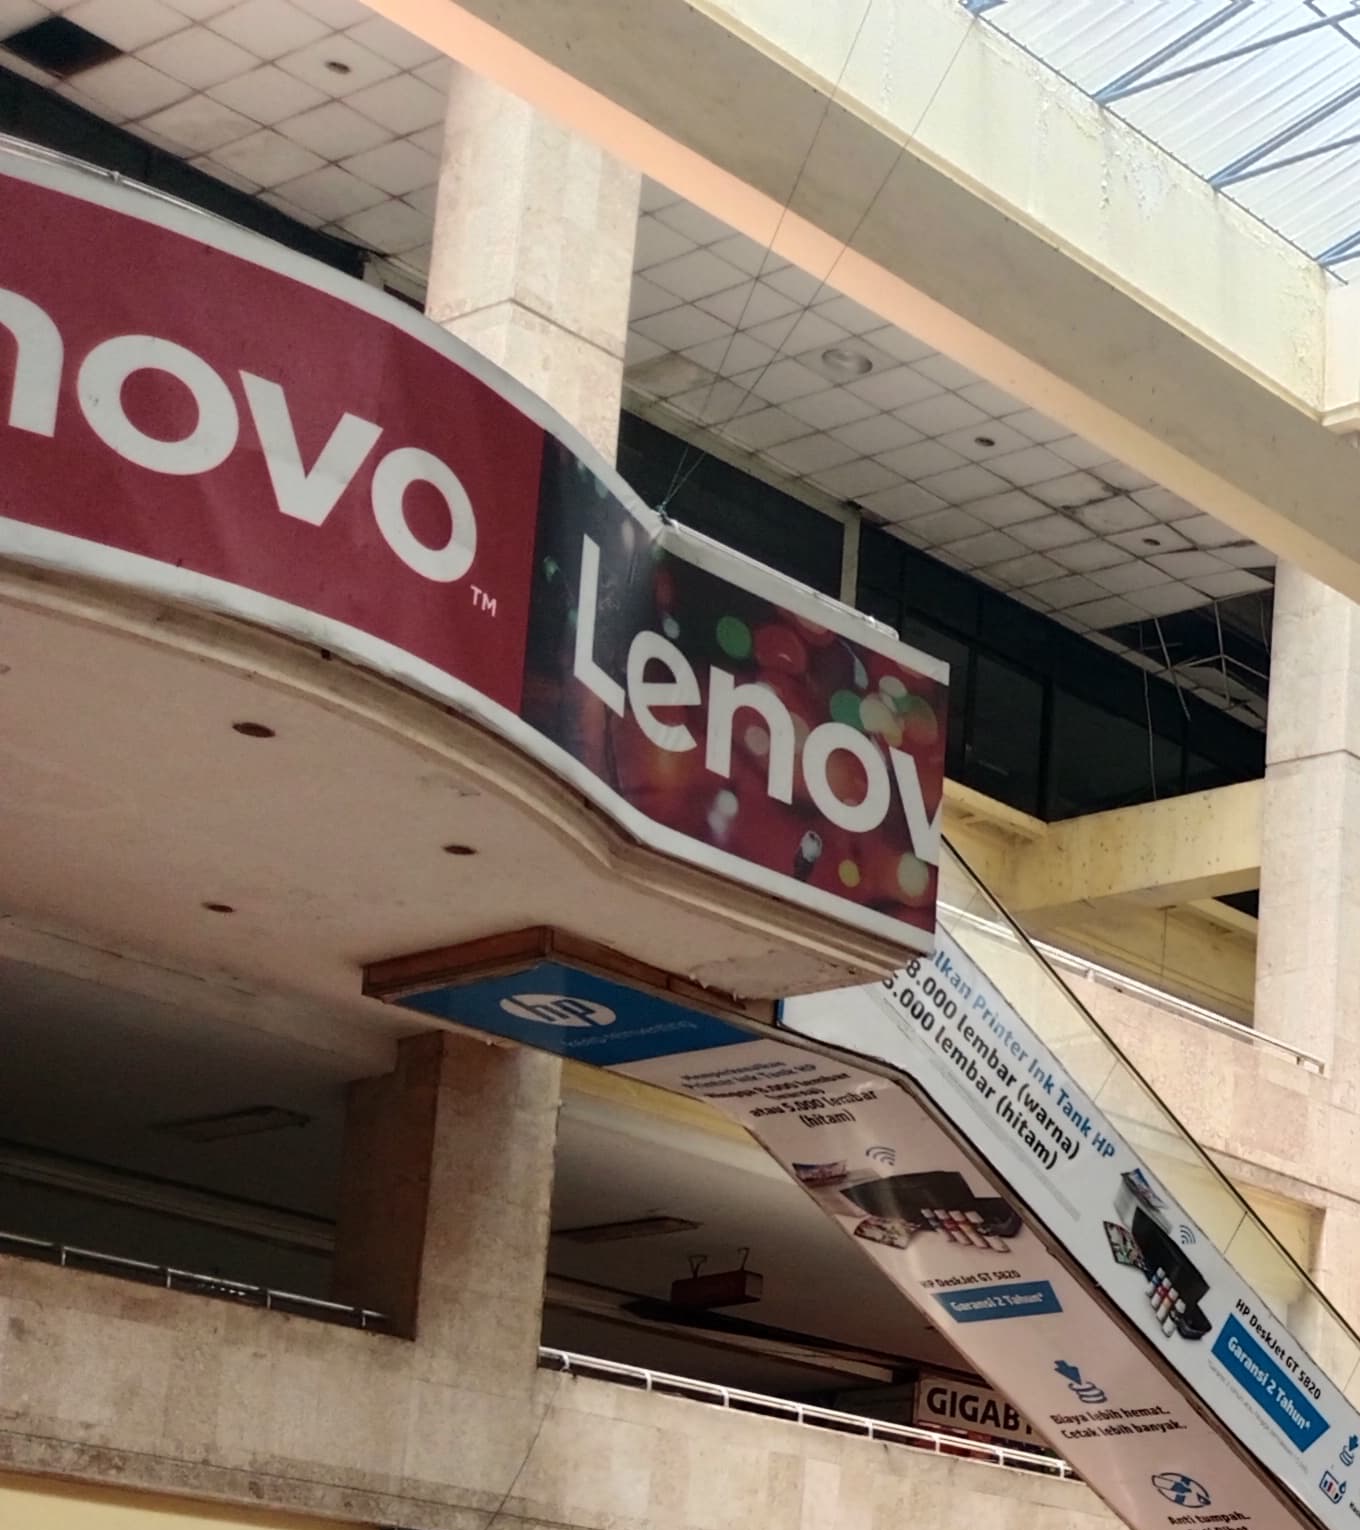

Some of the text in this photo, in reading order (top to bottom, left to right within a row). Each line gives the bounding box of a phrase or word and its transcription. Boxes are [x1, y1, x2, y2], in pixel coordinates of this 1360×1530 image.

[906, 959, 1081, 1160] 8.000 lembar (warna)
[935, 1025, 1058, 1169] lembar (hitam)
[973, 995, 1116, 1159] Printer Ink Tank HP
[1228, 1336, 1269, 1386] Garansi
[1235, 1299, 1321, 1400] HP DeskJet GT 5820
